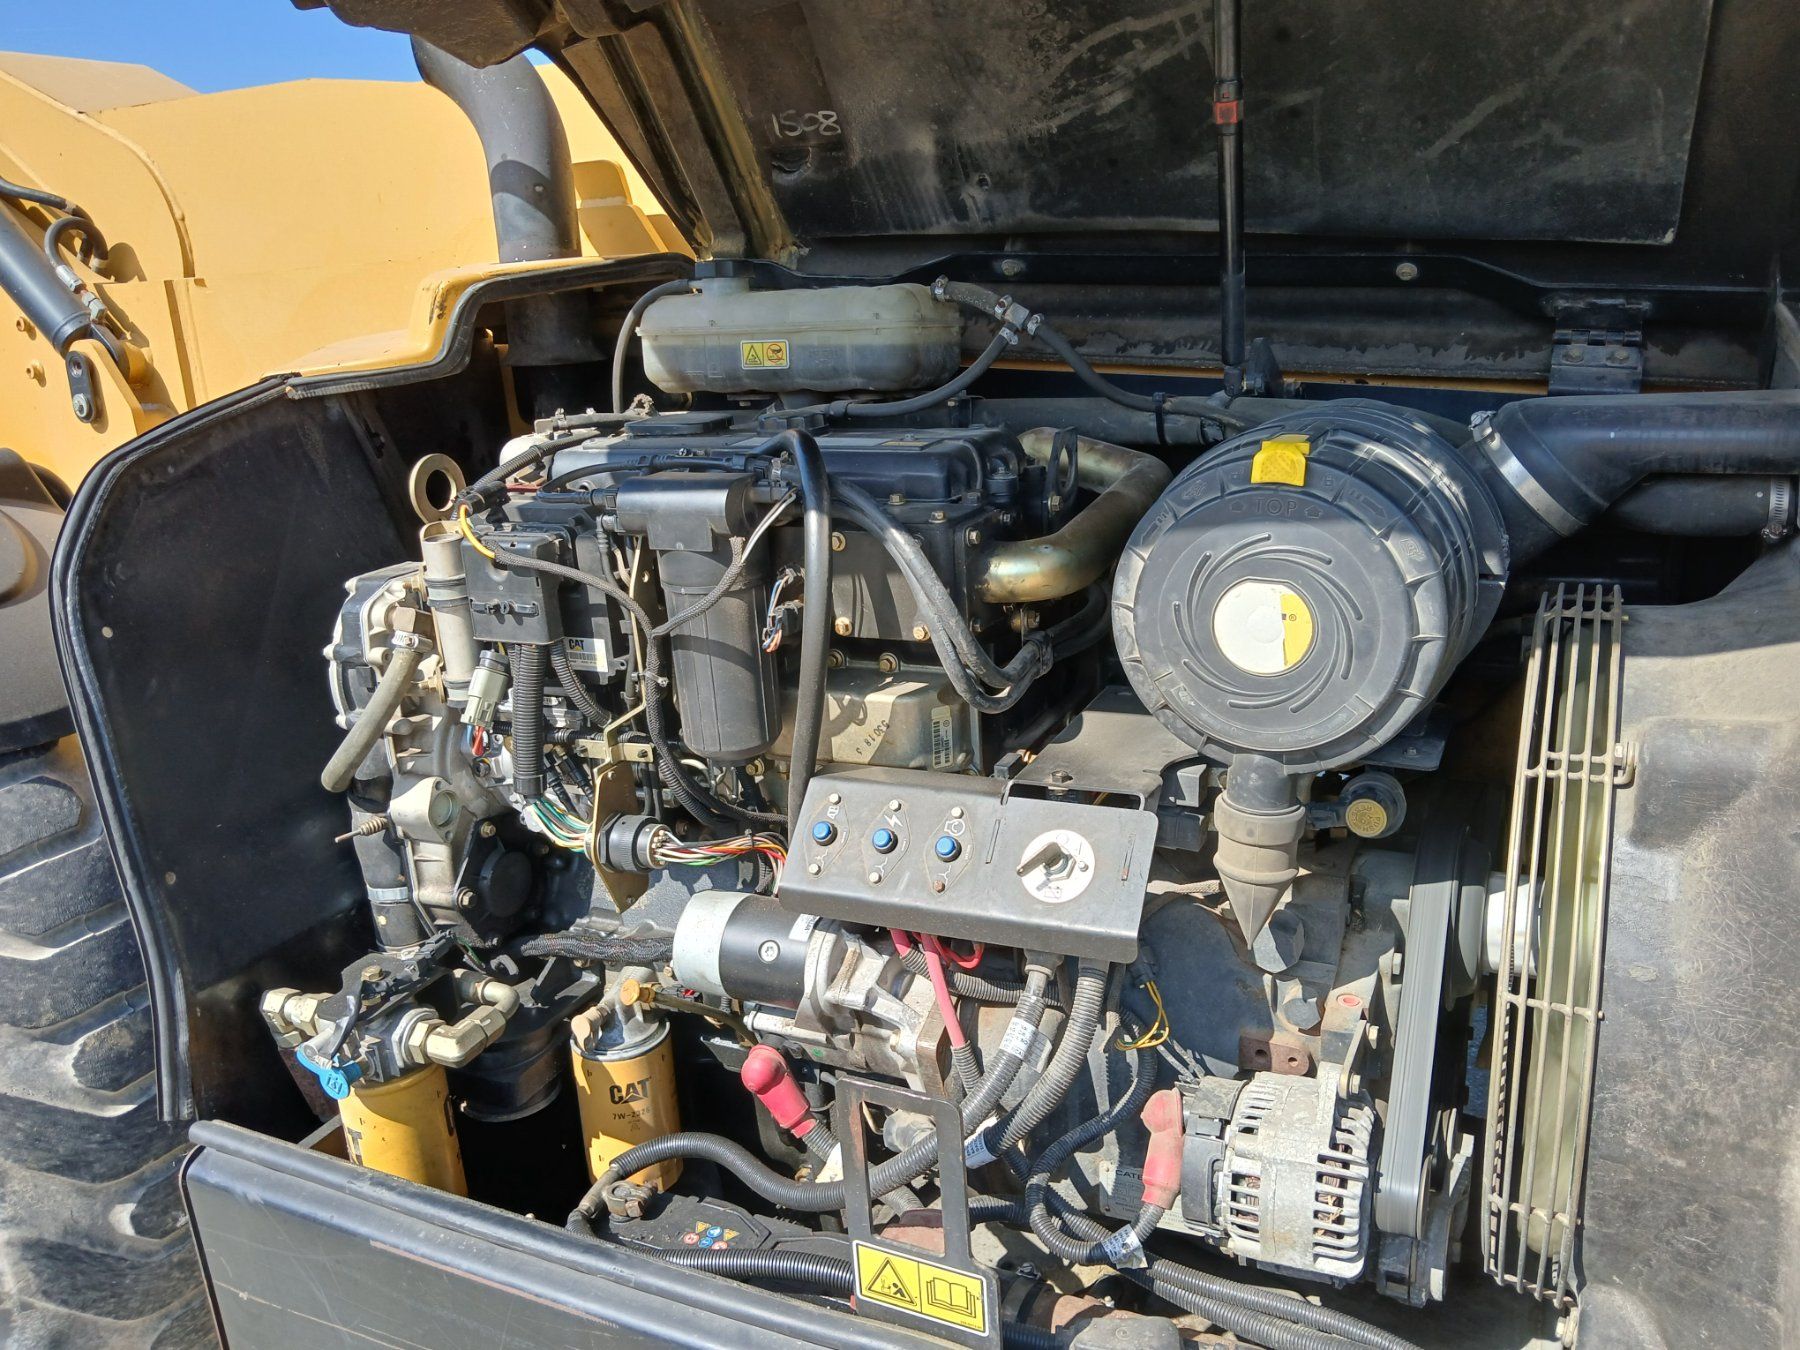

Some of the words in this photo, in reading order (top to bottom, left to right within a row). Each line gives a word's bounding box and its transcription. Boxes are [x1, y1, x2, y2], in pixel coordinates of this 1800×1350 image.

[771, 109, 842, 138] 1508
[1256, 497, 1297, 518] TOP
[568, 639, 585, 651] CAT
[609, 1077, 651, 1105] CAT
